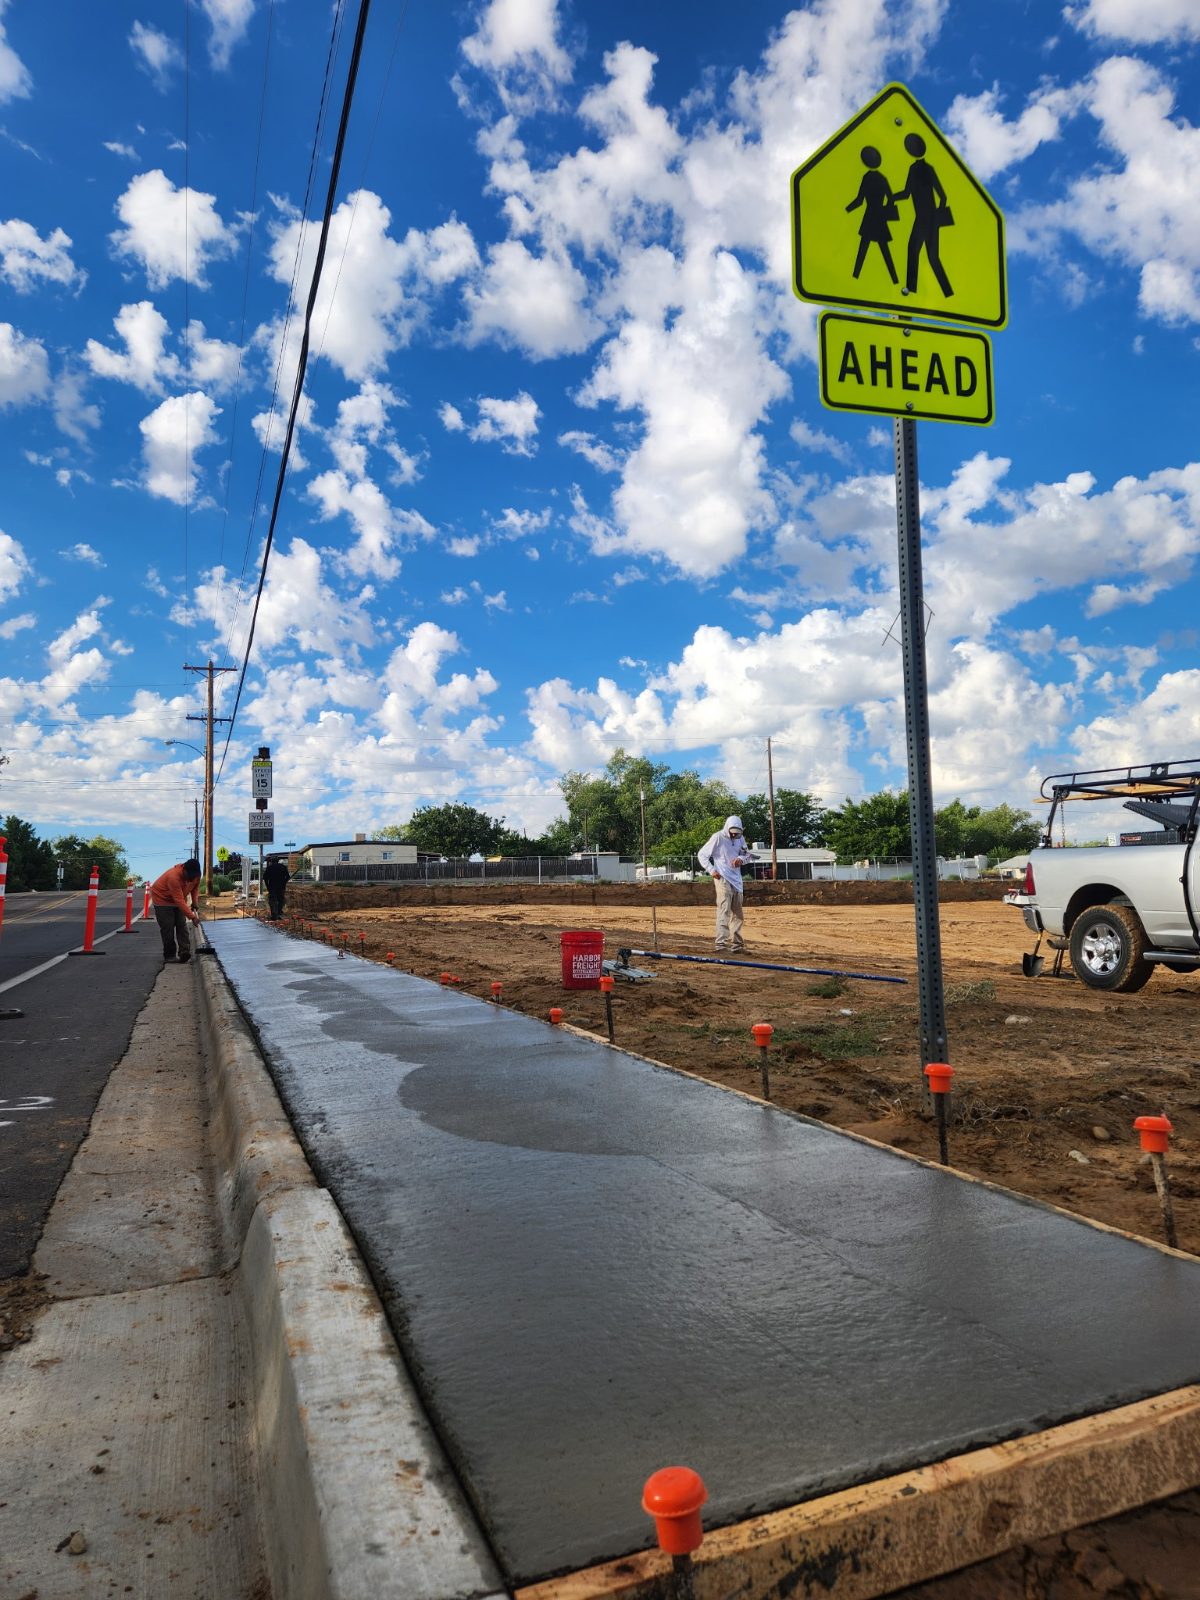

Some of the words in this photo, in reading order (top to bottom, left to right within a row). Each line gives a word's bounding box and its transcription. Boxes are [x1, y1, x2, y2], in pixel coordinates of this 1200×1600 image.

[837, 341, 978, 397] AHEAD
[256, 778, 268, 788] 15
[572, 961, 601, 969] FREIGHT
